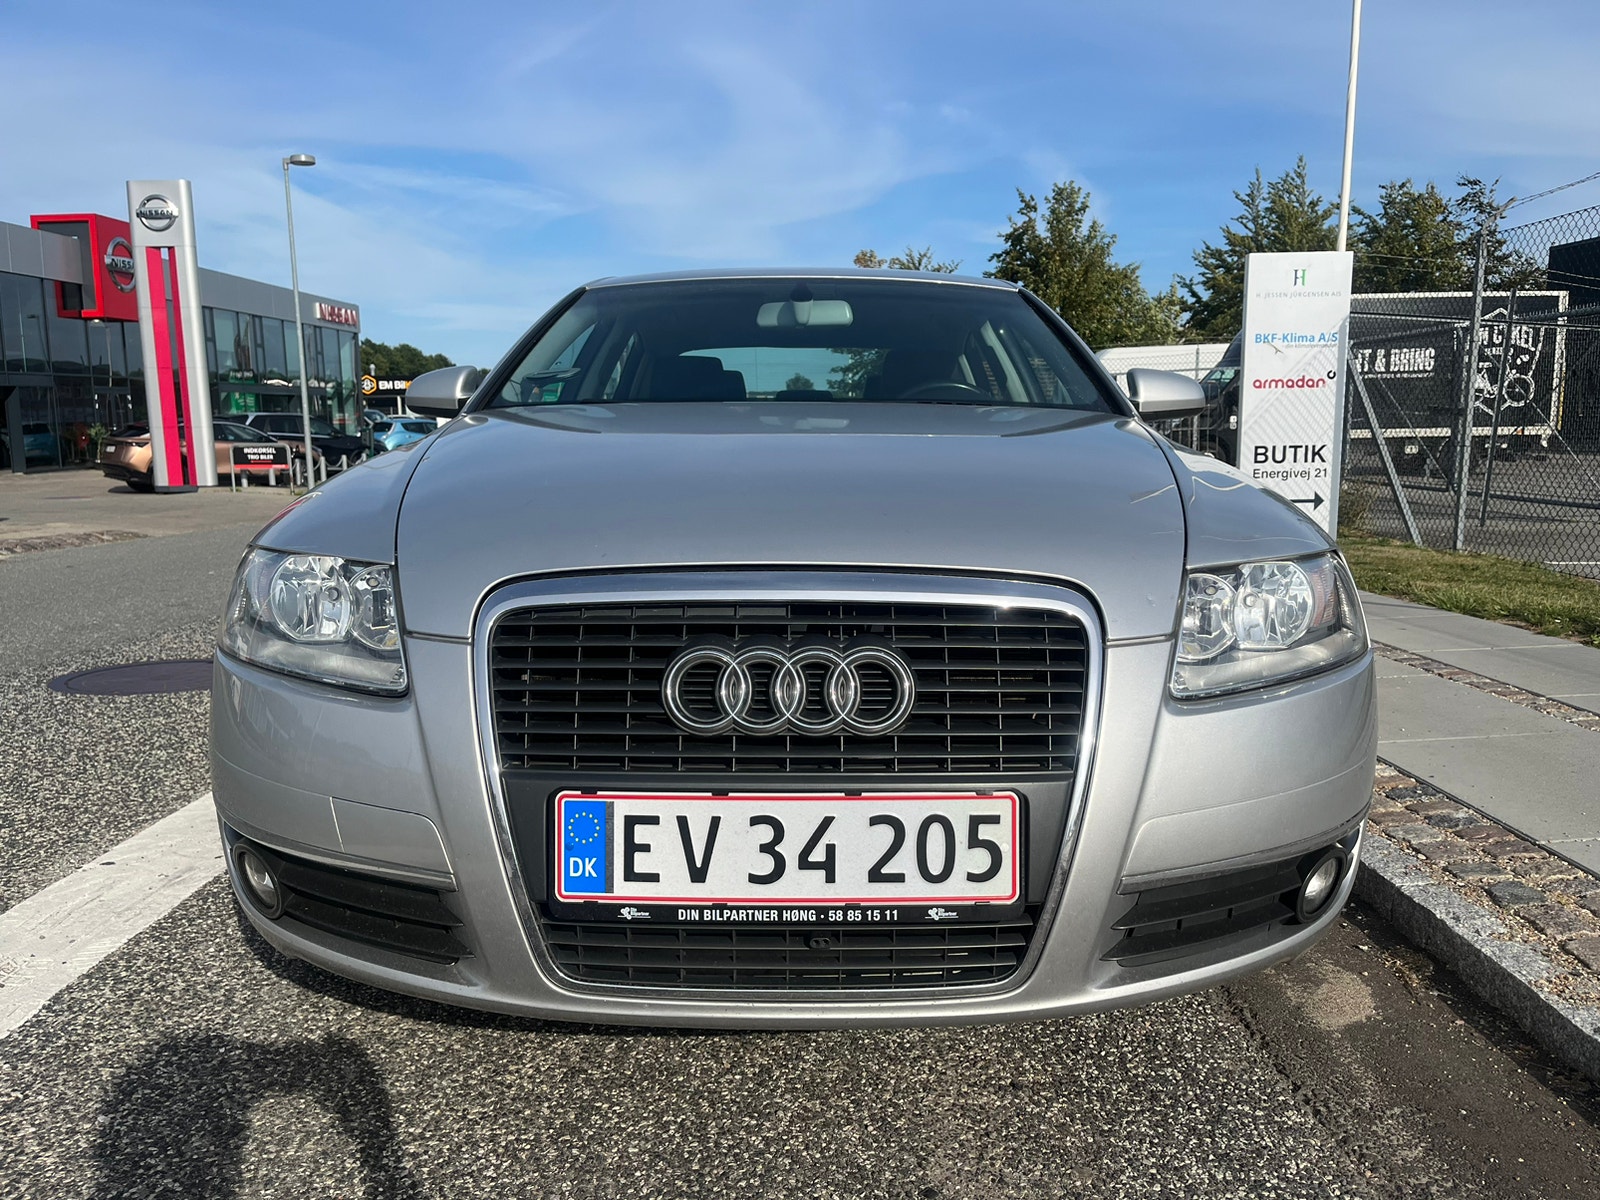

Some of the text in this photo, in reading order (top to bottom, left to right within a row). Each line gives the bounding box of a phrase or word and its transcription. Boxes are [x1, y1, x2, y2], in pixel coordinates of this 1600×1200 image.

[139, 209, 174, 217] NISSAN
[316, 302, 358, 326] NISSAN
[1254, 331, 1338, 344] BKF-Klima A/S
[1390, 347, 1436, 372] BRING
[1252, 374, 1327, 389] armadan
[1253, 444, 1328, 464] BUTIK
[1253, 467, 1328, 481] Energivej 21
[623, 813, 1003, 885] EV 34 205
[569, 857, 598, 878] DK
[678, 909, 898, 922] DIN BILPARTNER HØNG 58 85 15 11
